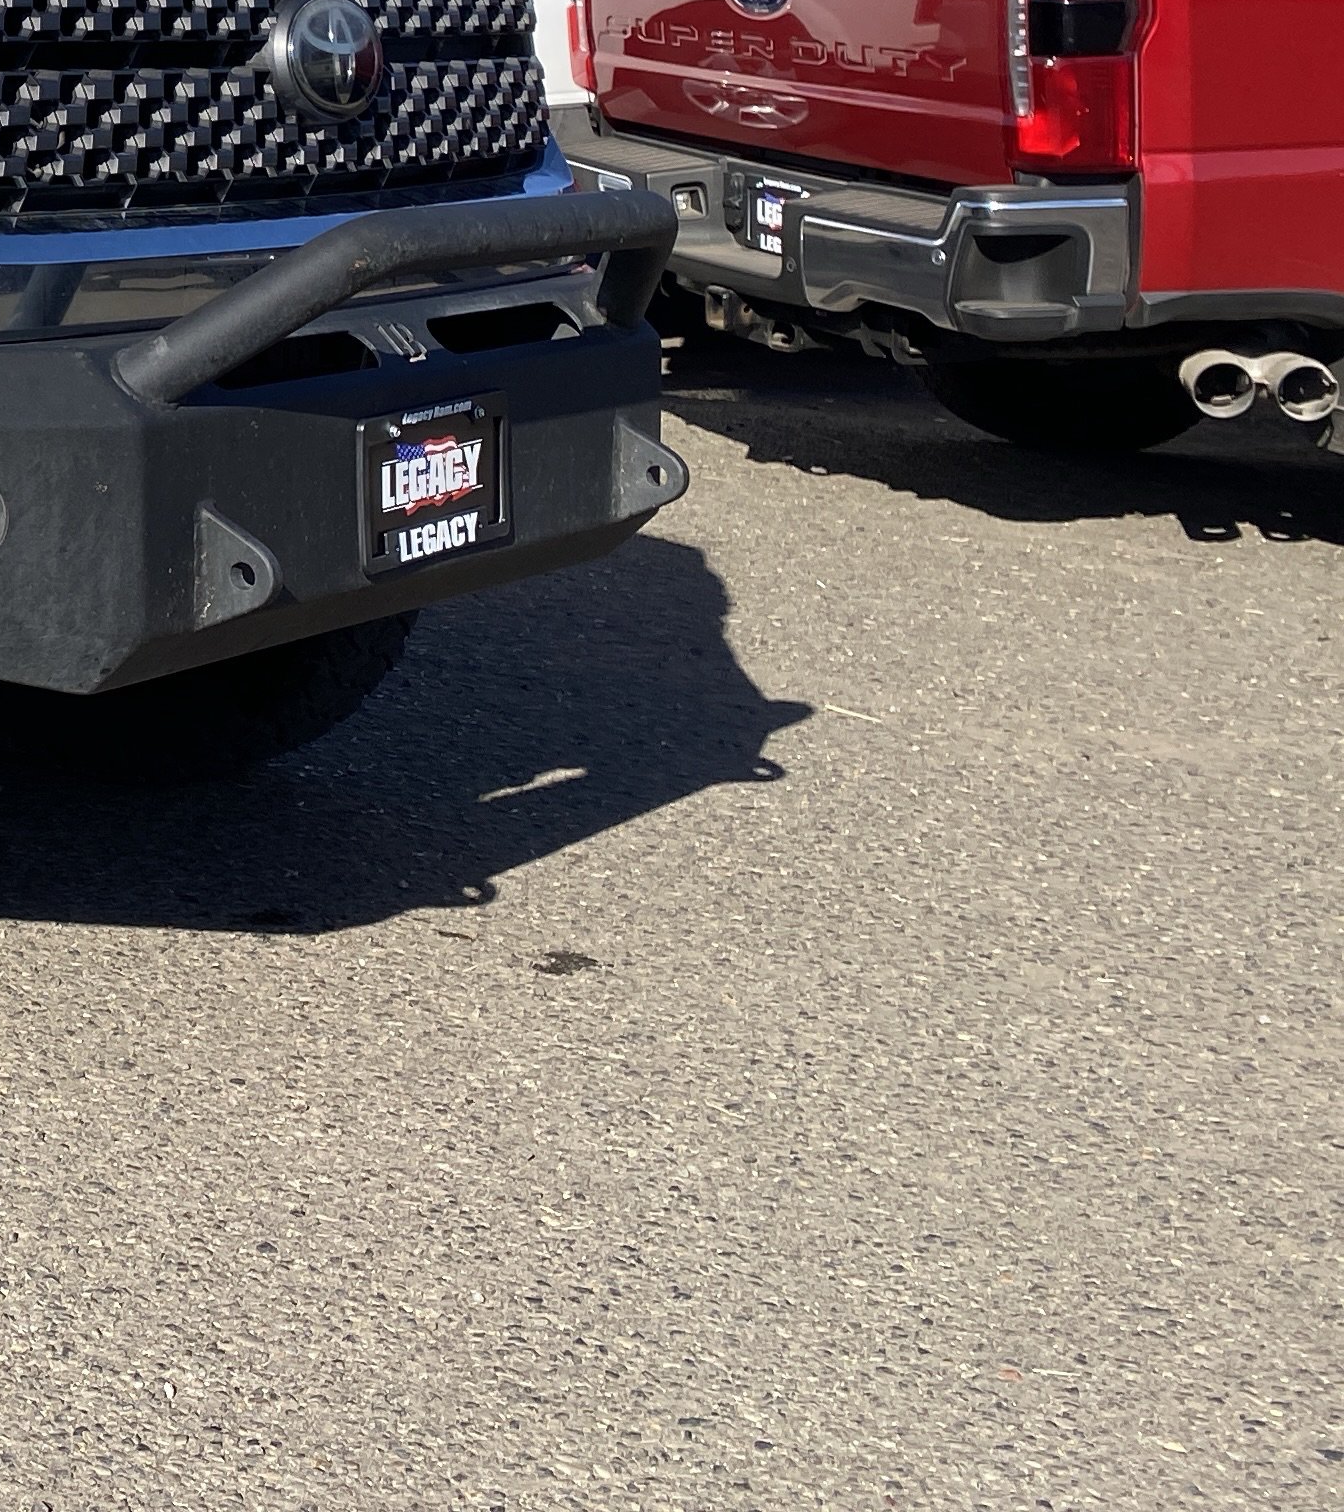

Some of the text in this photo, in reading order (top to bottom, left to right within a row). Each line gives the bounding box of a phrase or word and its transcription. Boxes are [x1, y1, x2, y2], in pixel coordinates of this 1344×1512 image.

[599, 15, 967, 82] SUPER DUTY
[381, 442, 482, 510] LEGACY
[398, 511, 480, 563] LEGACY
